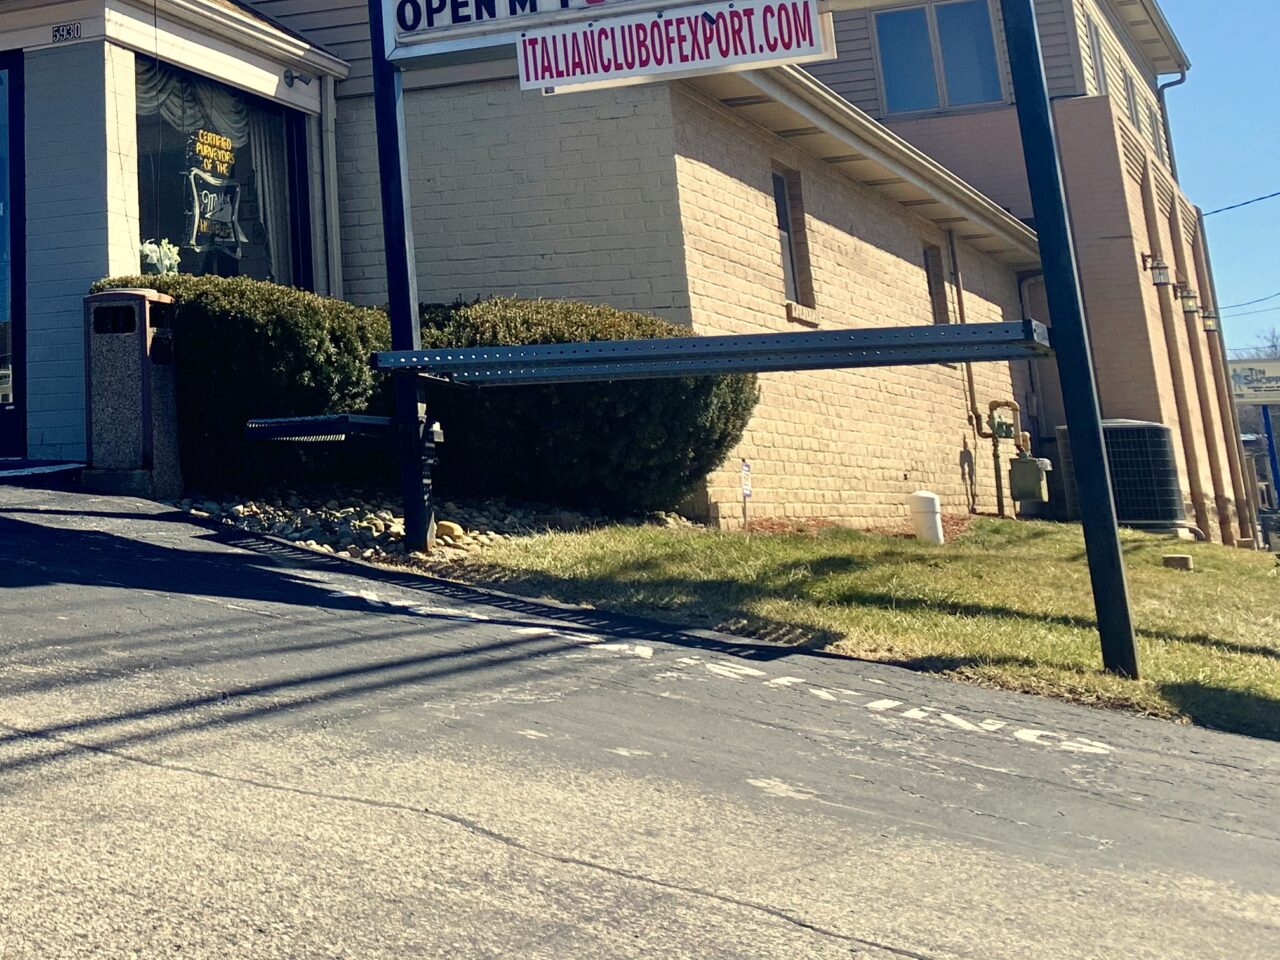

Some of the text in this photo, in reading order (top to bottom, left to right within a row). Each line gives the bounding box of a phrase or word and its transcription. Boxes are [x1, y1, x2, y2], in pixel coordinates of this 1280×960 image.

[52, 22, 81, 42] 5930
[522, 0, 814, 82] ITALIANCLUBOFEXPORT.COM
[199, 129, 232, 150] CERTIFIED
[203, 158, 214, 171] OF
